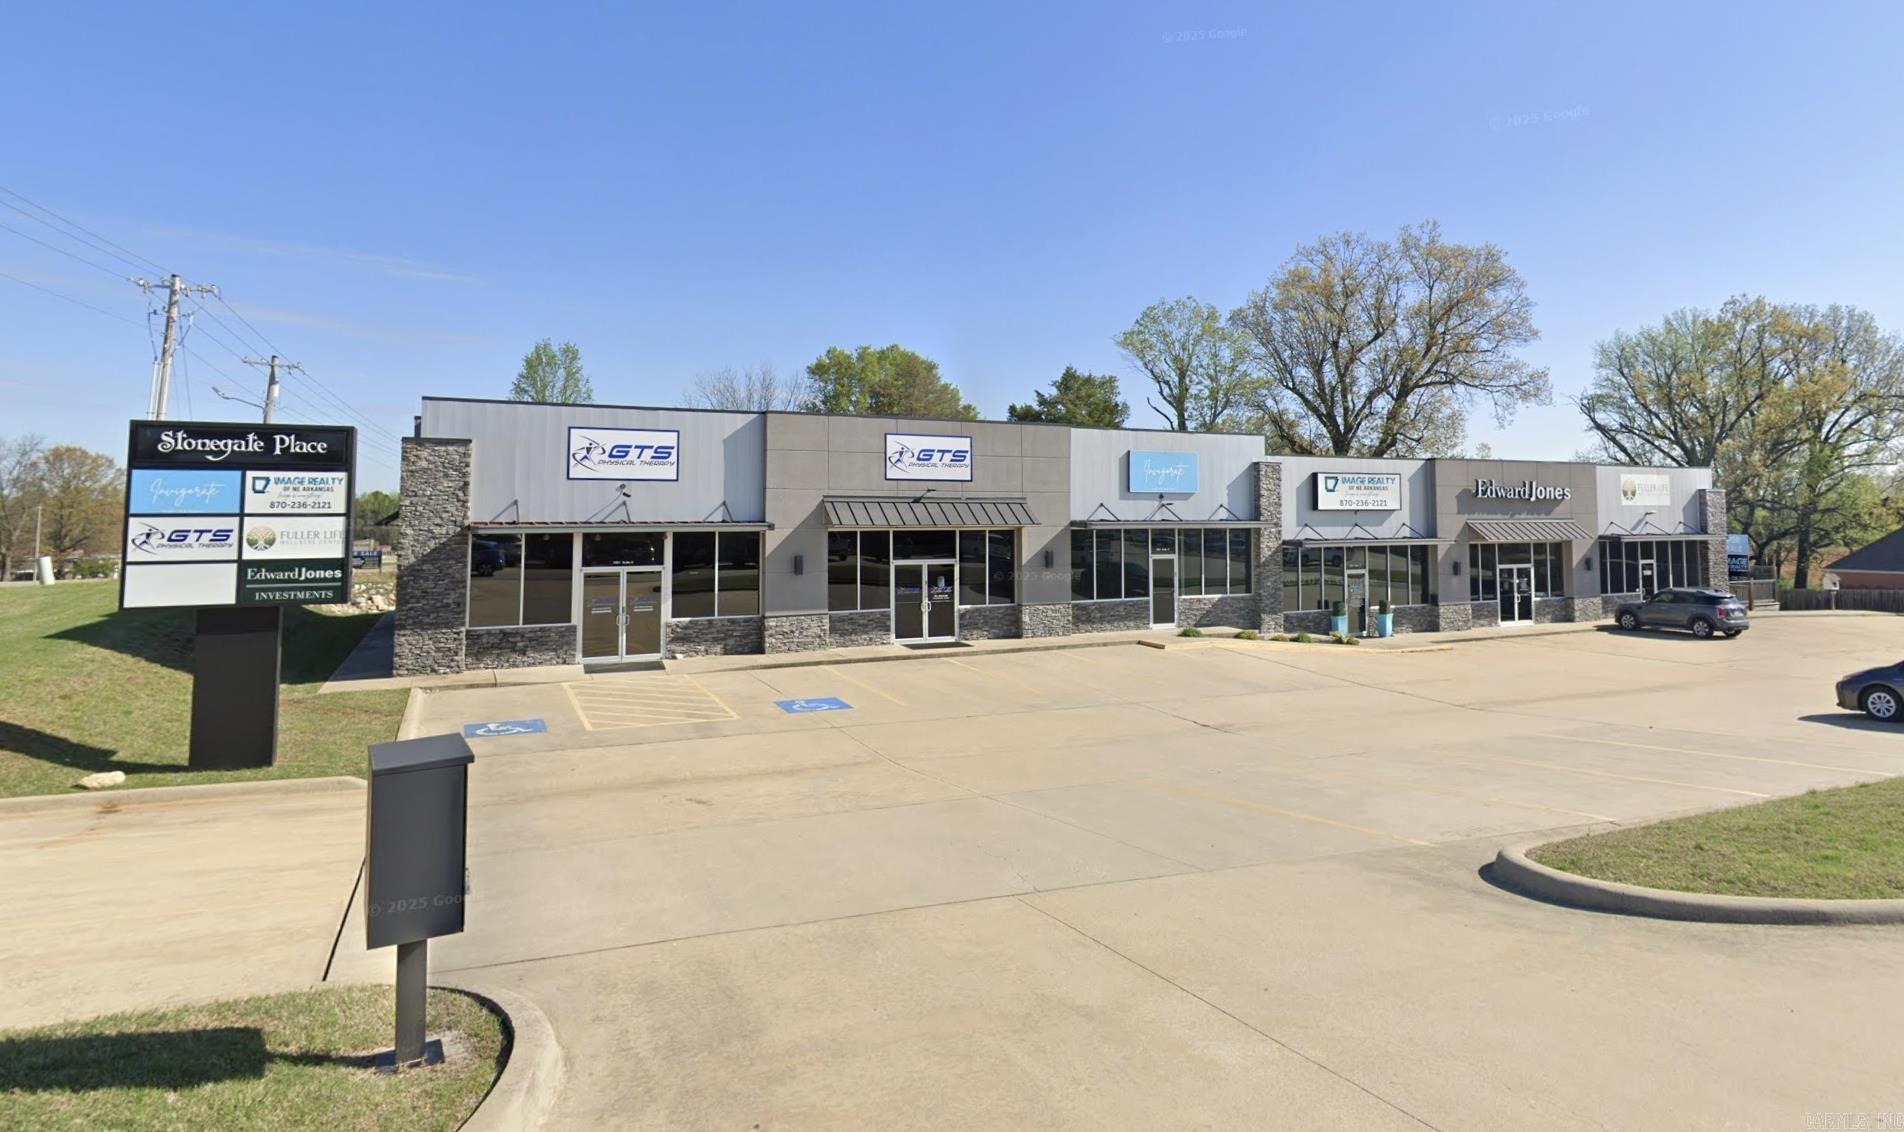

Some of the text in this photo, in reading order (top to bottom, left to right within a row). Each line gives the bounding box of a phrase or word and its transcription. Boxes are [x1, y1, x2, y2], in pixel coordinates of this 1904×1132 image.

[157, 430, 328, 461] Stonegate Place
[607, 444, 675, 460] GTS
[916, 448, 969, 462] GTS
[274, 476, 344, 485] IMAGE REALTY
[1341, 476, 1396, 485] IMAGE REALTY
[150, 478, 226, 507] Invigorate
[269, 501, 332, 509] 870-236-2121
[1340, 499, 1388, 507] 870-236-2121
[167, 529, 234, 542] GTS
[280, 530, 346, 540] FULLER LIFE
[255, 590, 334, 601] INVESTMENTS
